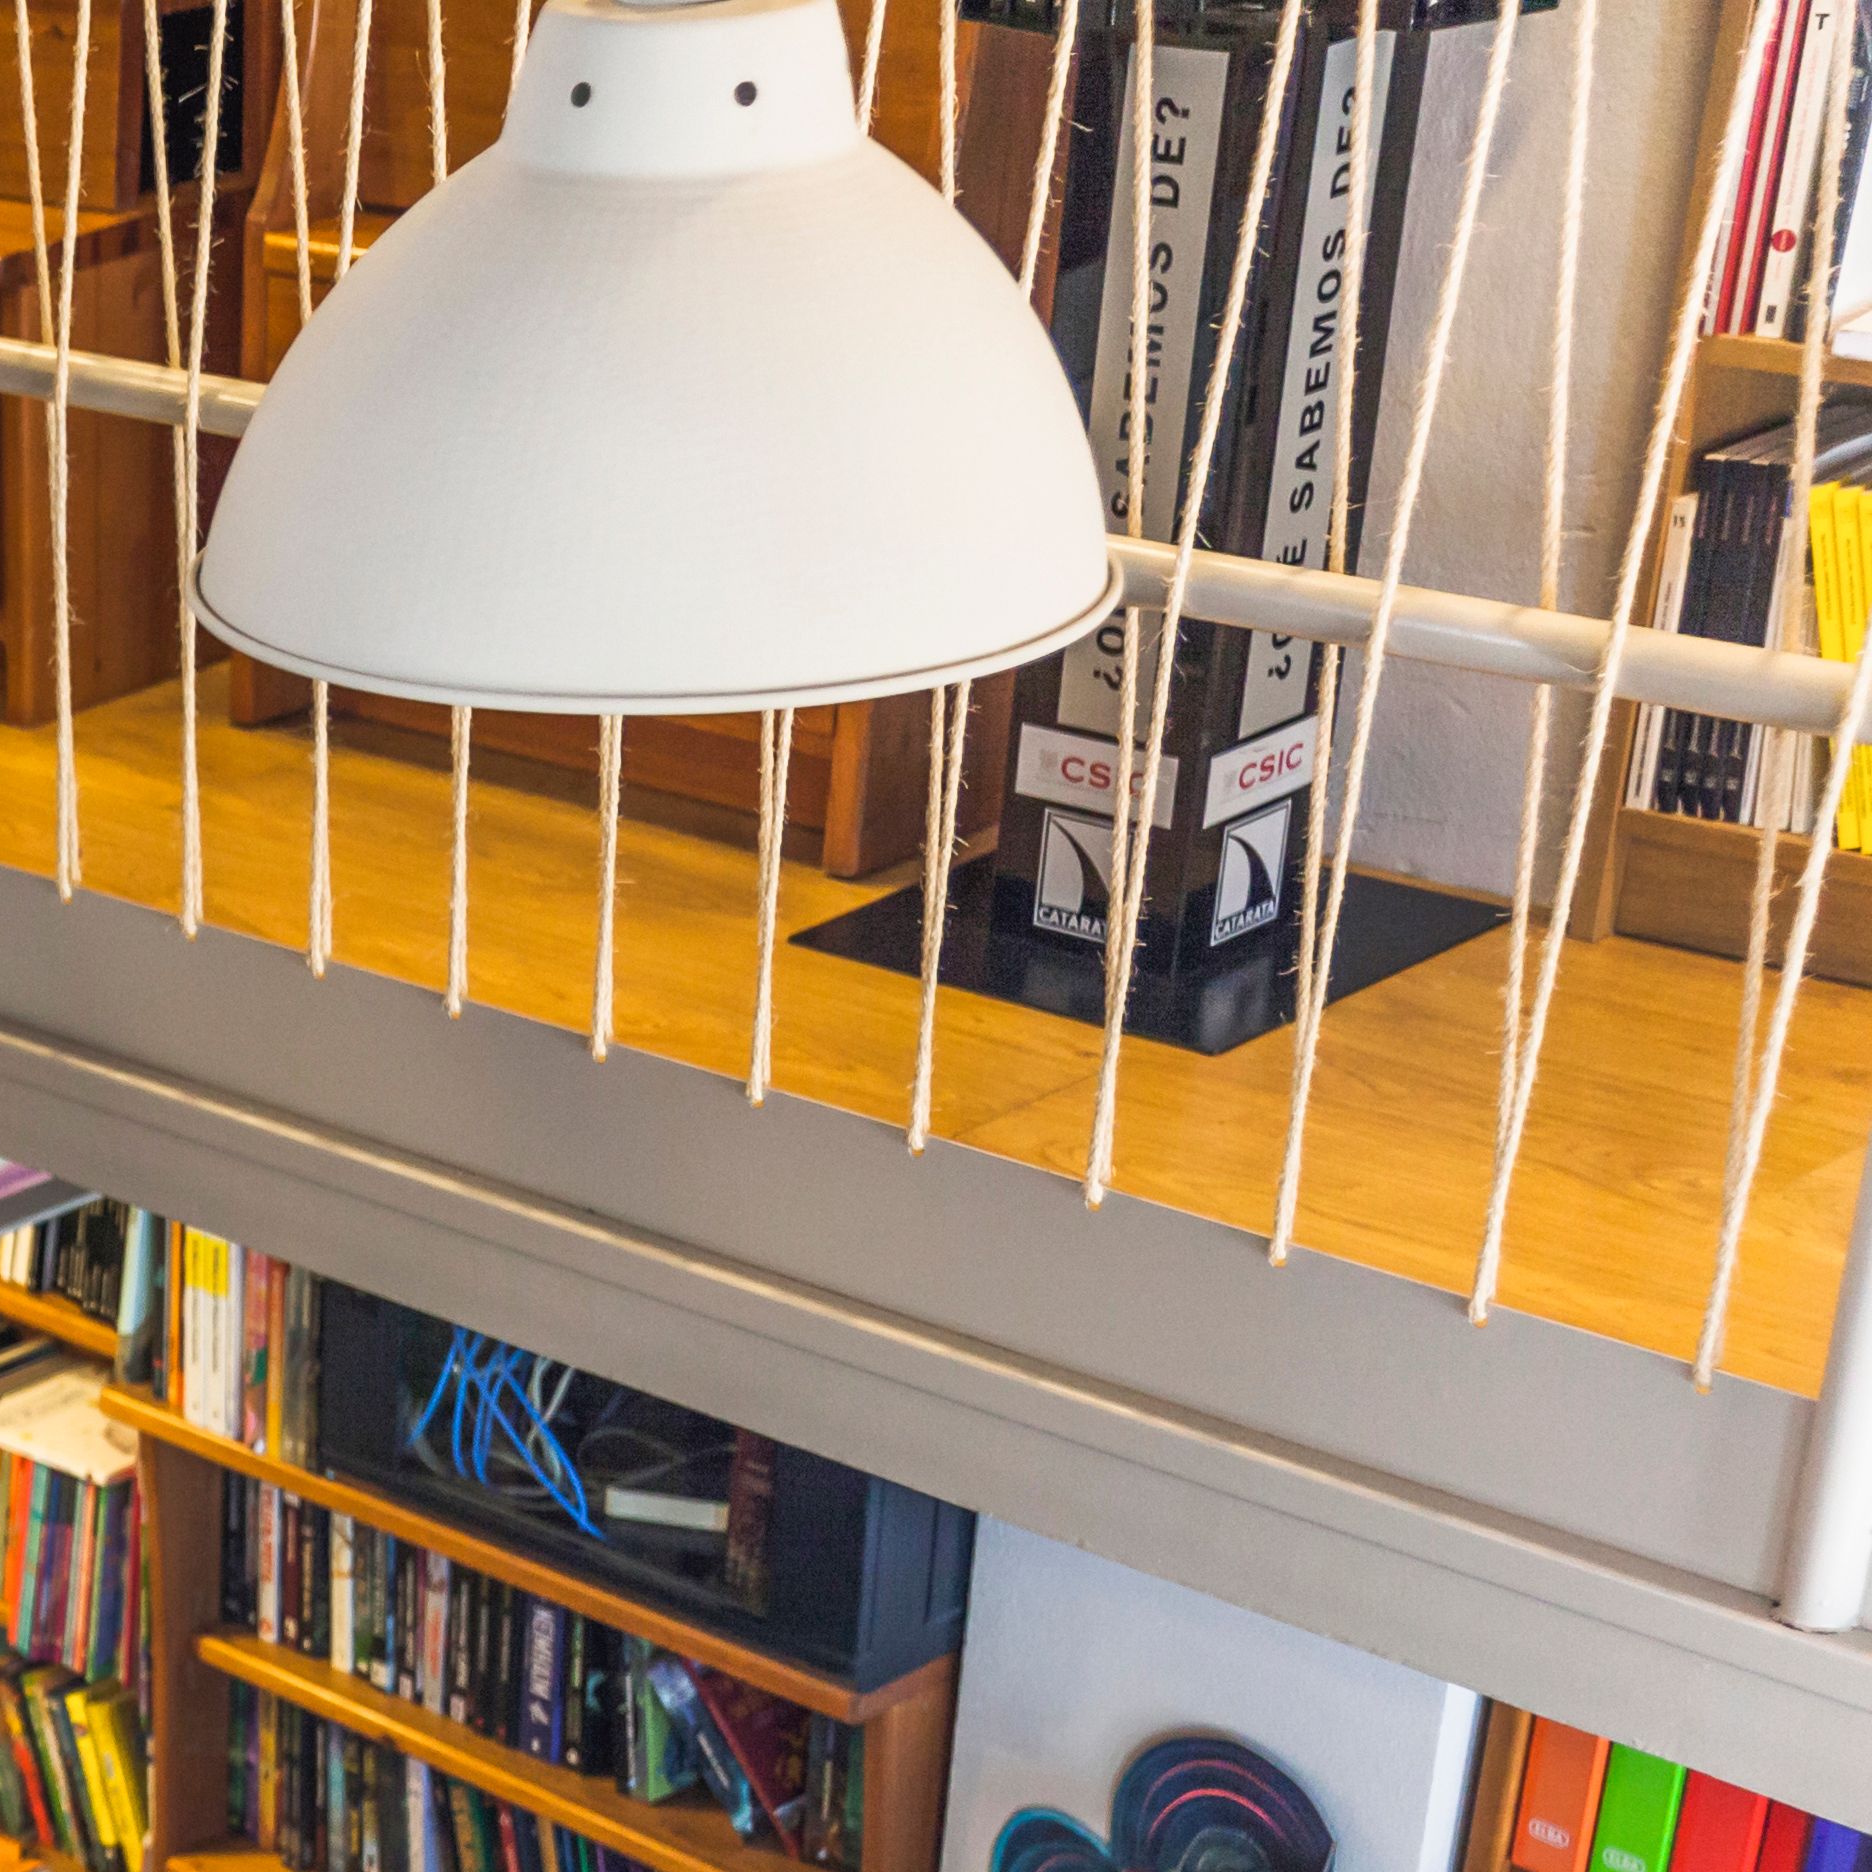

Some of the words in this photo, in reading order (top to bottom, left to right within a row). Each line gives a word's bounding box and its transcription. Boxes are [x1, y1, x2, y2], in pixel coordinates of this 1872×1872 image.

[1290, 229, 1346, 513] SABEMOS
[1061, 757, 1145, 796] CSC
[1238, 743, 1304, 790] CSIC
[1039, 908, 1108, 937] CATARA
[1214, 900, 1274, 939] CATARATA
[1534, 1820, 1566, 1846] ELBA
